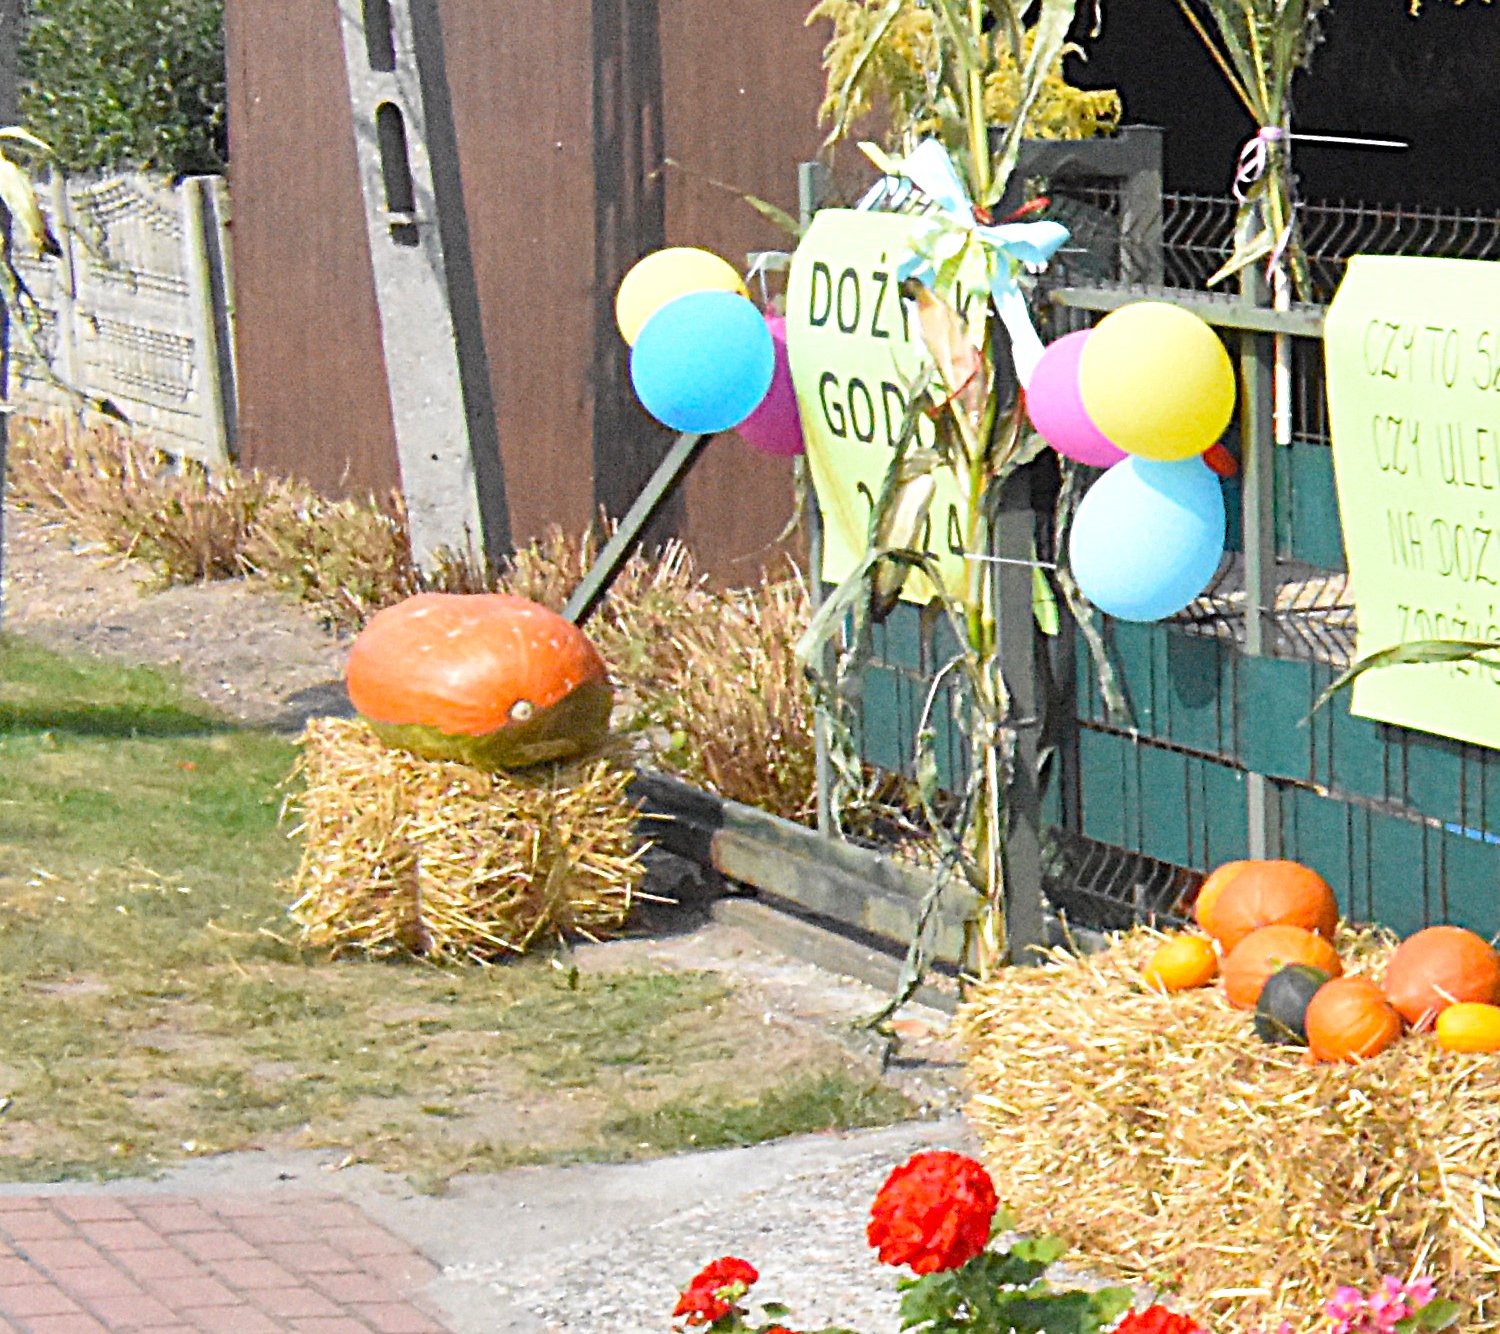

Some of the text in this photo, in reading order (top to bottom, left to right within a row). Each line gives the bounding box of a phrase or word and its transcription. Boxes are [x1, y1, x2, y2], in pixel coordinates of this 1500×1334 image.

[1364, 319, 1416, 382] CZY
[1425, 326, 1459, 388] TO
[1373, 415, 1421, 477] CZY
[1387, 509, 1424, 572] NA
